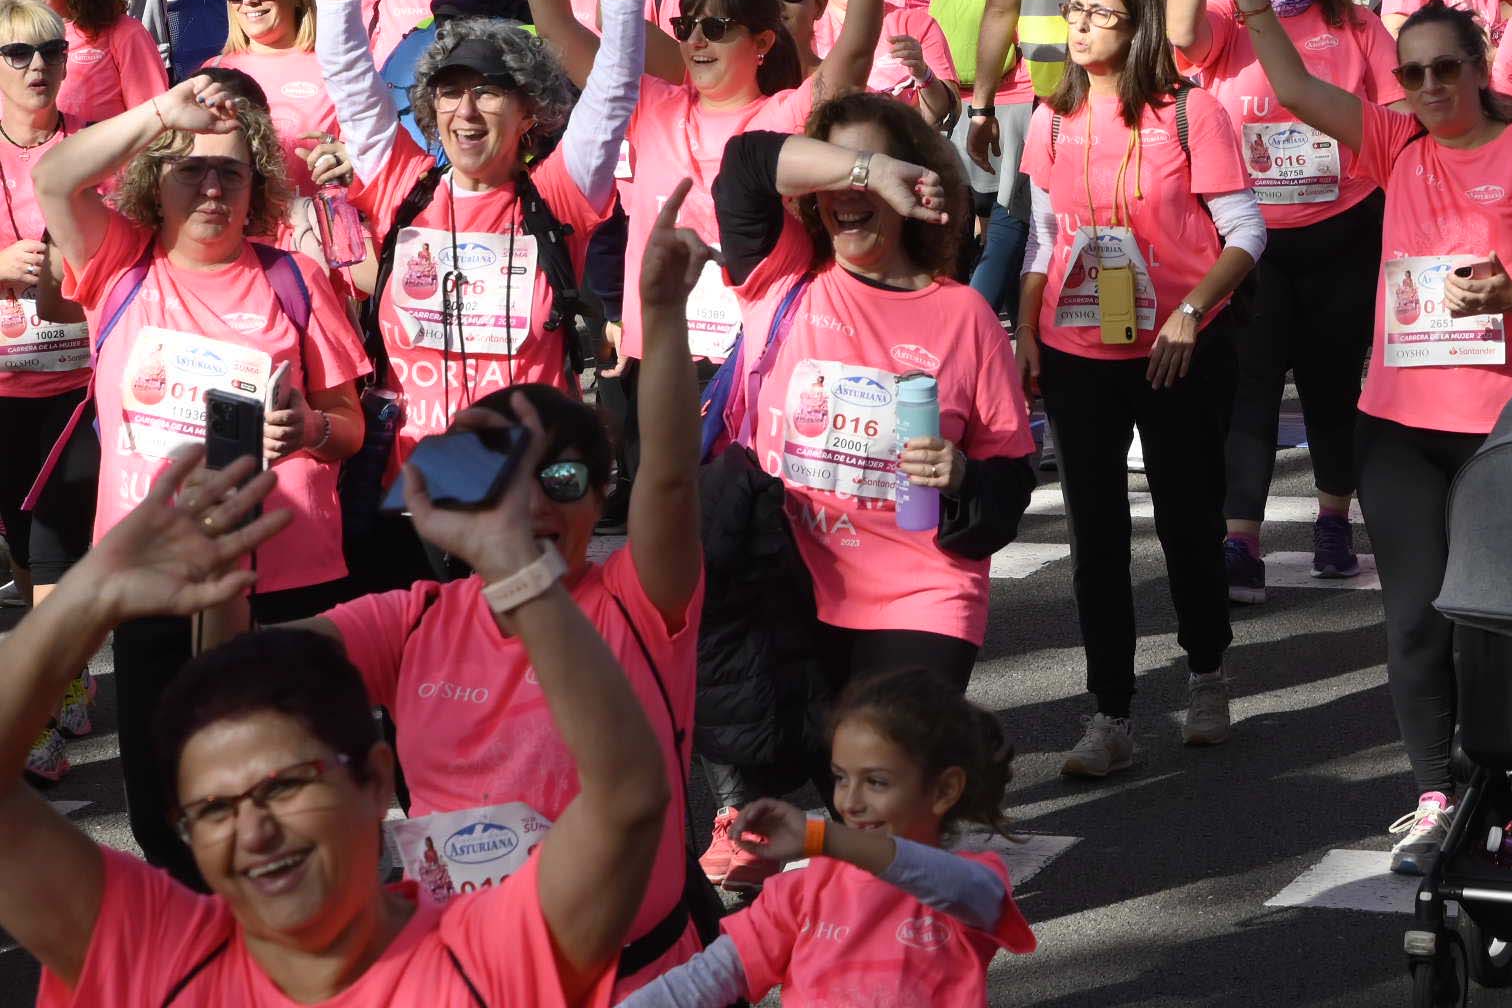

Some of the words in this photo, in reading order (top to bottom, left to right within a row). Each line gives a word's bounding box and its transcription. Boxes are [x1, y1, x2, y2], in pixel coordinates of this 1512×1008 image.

[1241, 95, 1270, 117] TU
[1274, 155, 1306, 168] 016
[1430, 319, 1454, 329] 2651
[36, 329, 65, 340] 10028
[1396, 349, 1429, 359] OYSHO
[1458, 347, 1496, 356] Santander
[835, 383, 887, 403] ASTURIANA
[832, 413, 879, 437] 016
[832, 436, 869, 454] 20001
[796, 447, 833, 461] CARRERA
[834, 454, 846, 462] DE
[847, 455, 858, 465] LA
[858, 458, 884, 469] MUJER
[791, 462, 831, 480] OYSHO
[451, 837, 514, 858] ASTURIANA
